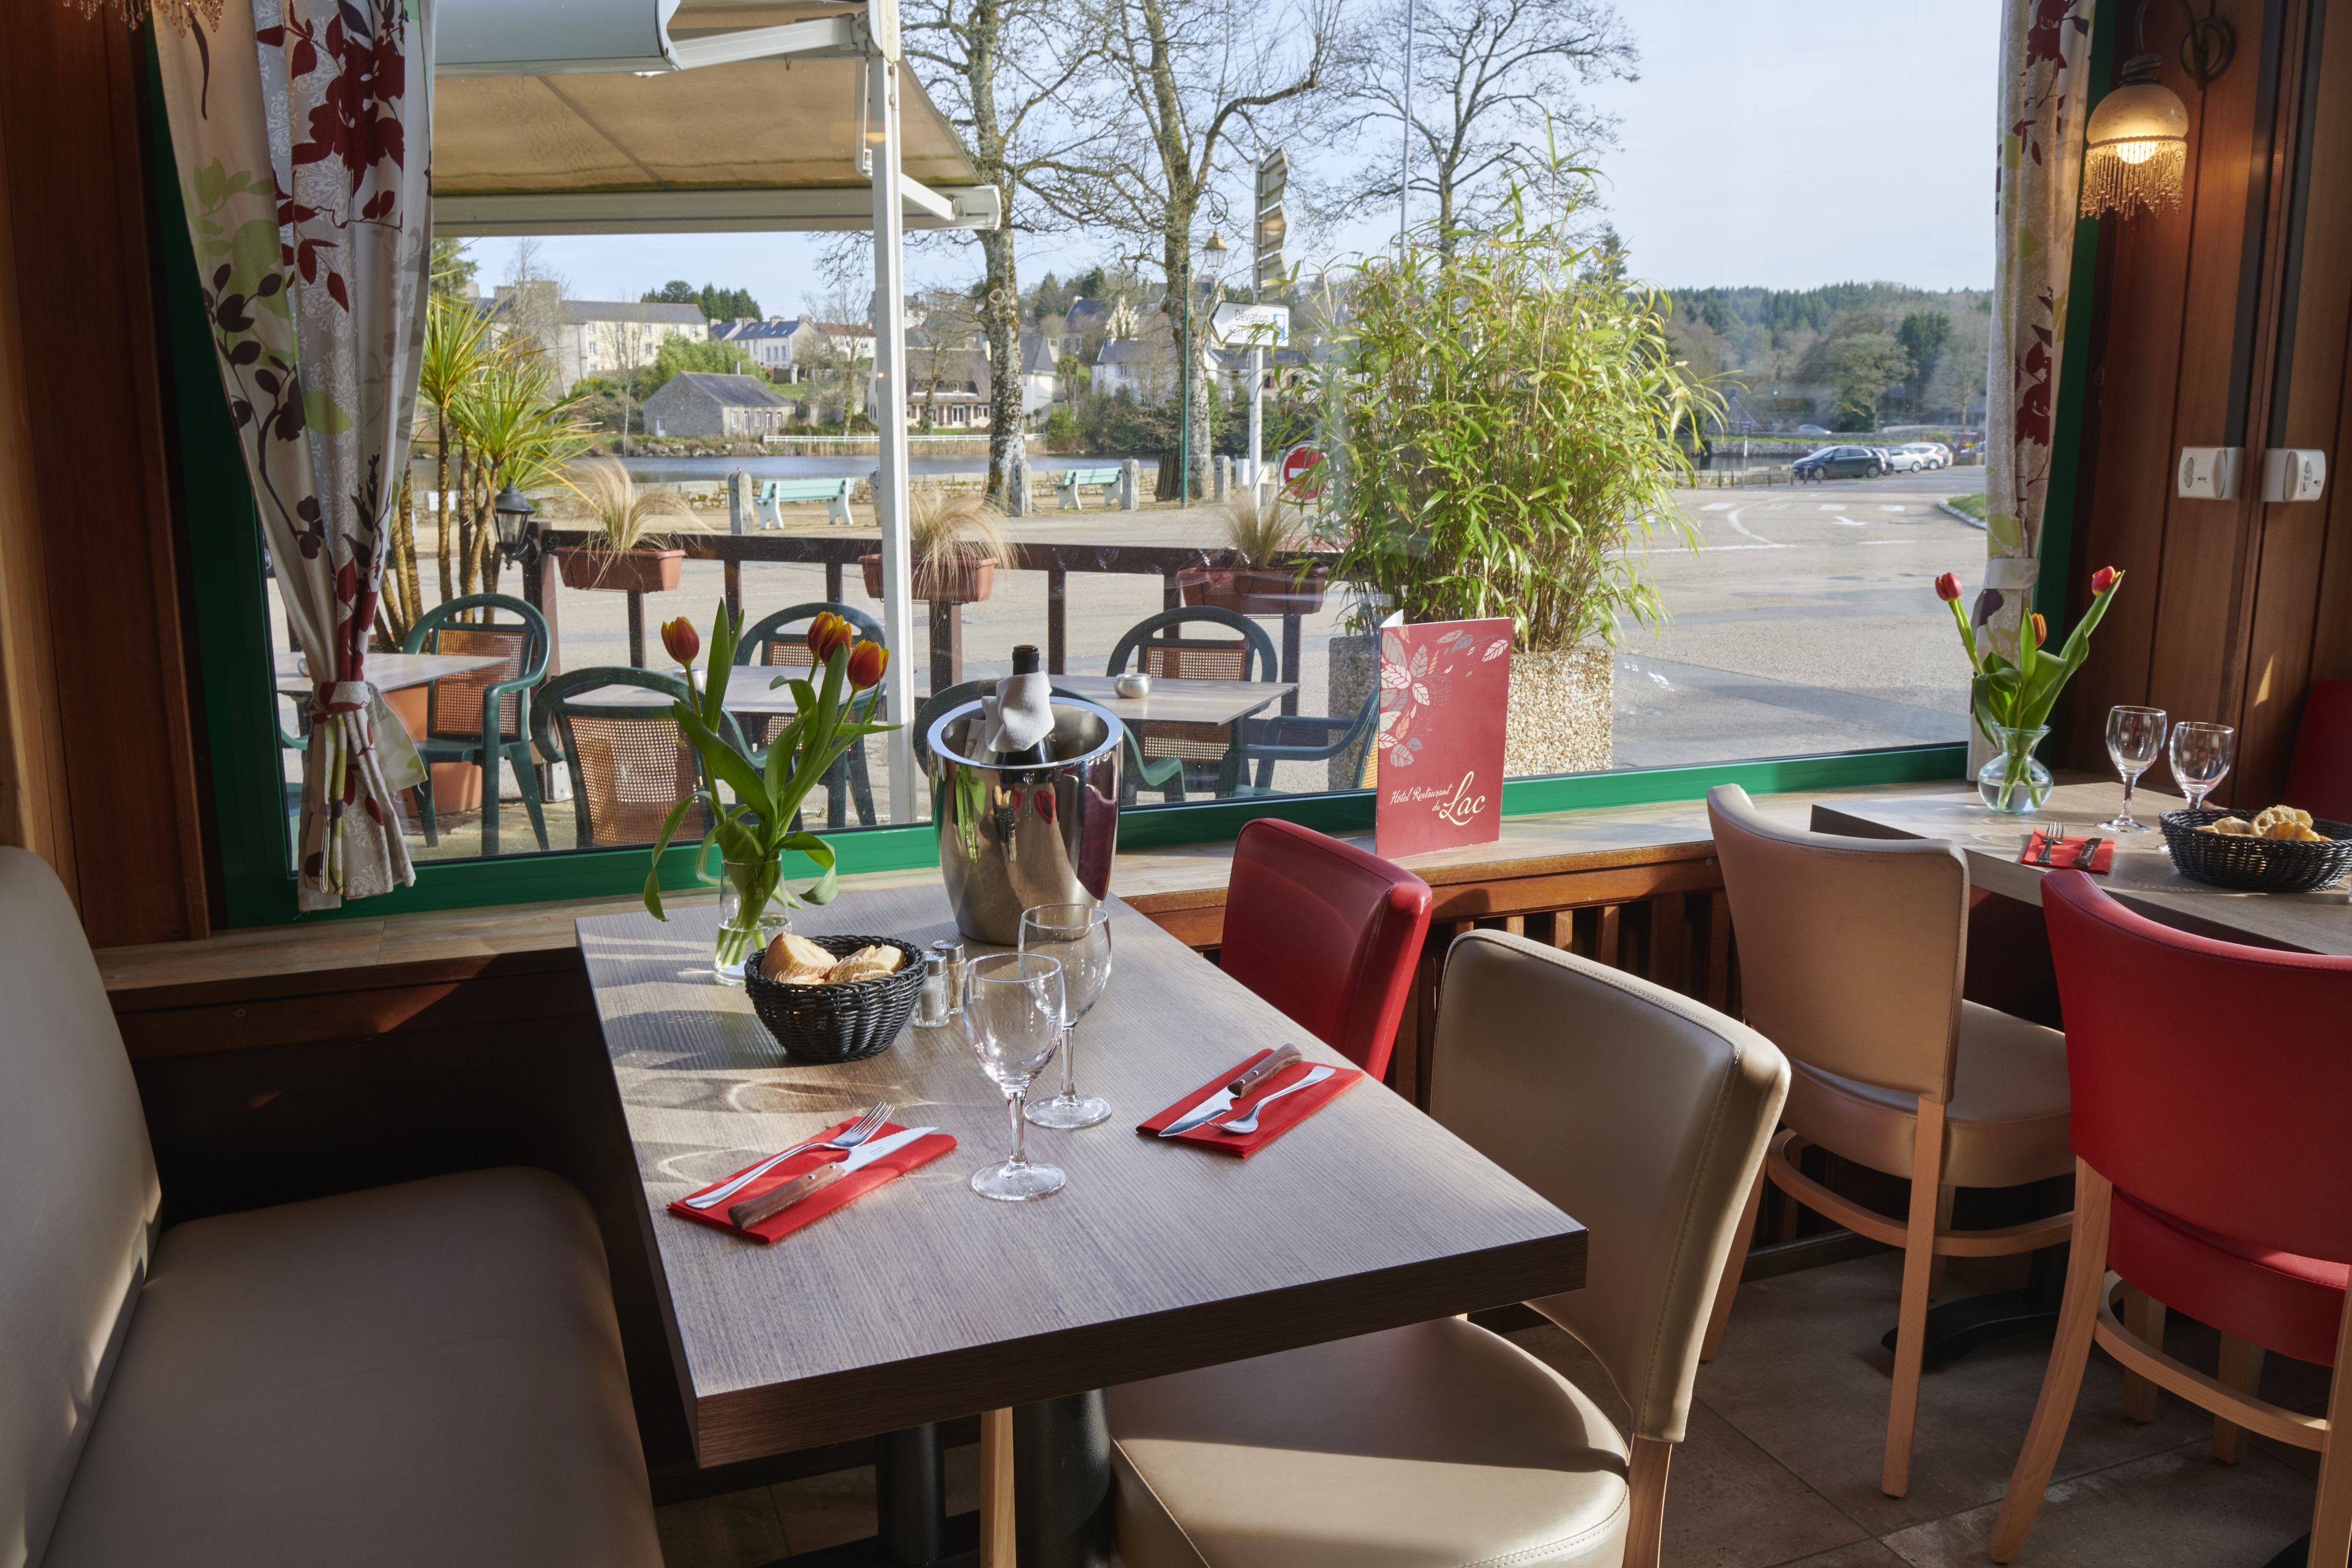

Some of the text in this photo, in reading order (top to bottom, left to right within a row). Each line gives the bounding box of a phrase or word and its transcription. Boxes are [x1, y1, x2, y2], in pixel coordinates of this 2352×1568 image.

[1235, 309, 1268, 323] Déviation
[1390, 783, 1453, 805] Hôtel Restaurant
[1432, 771, 1485, 826] du Lac
